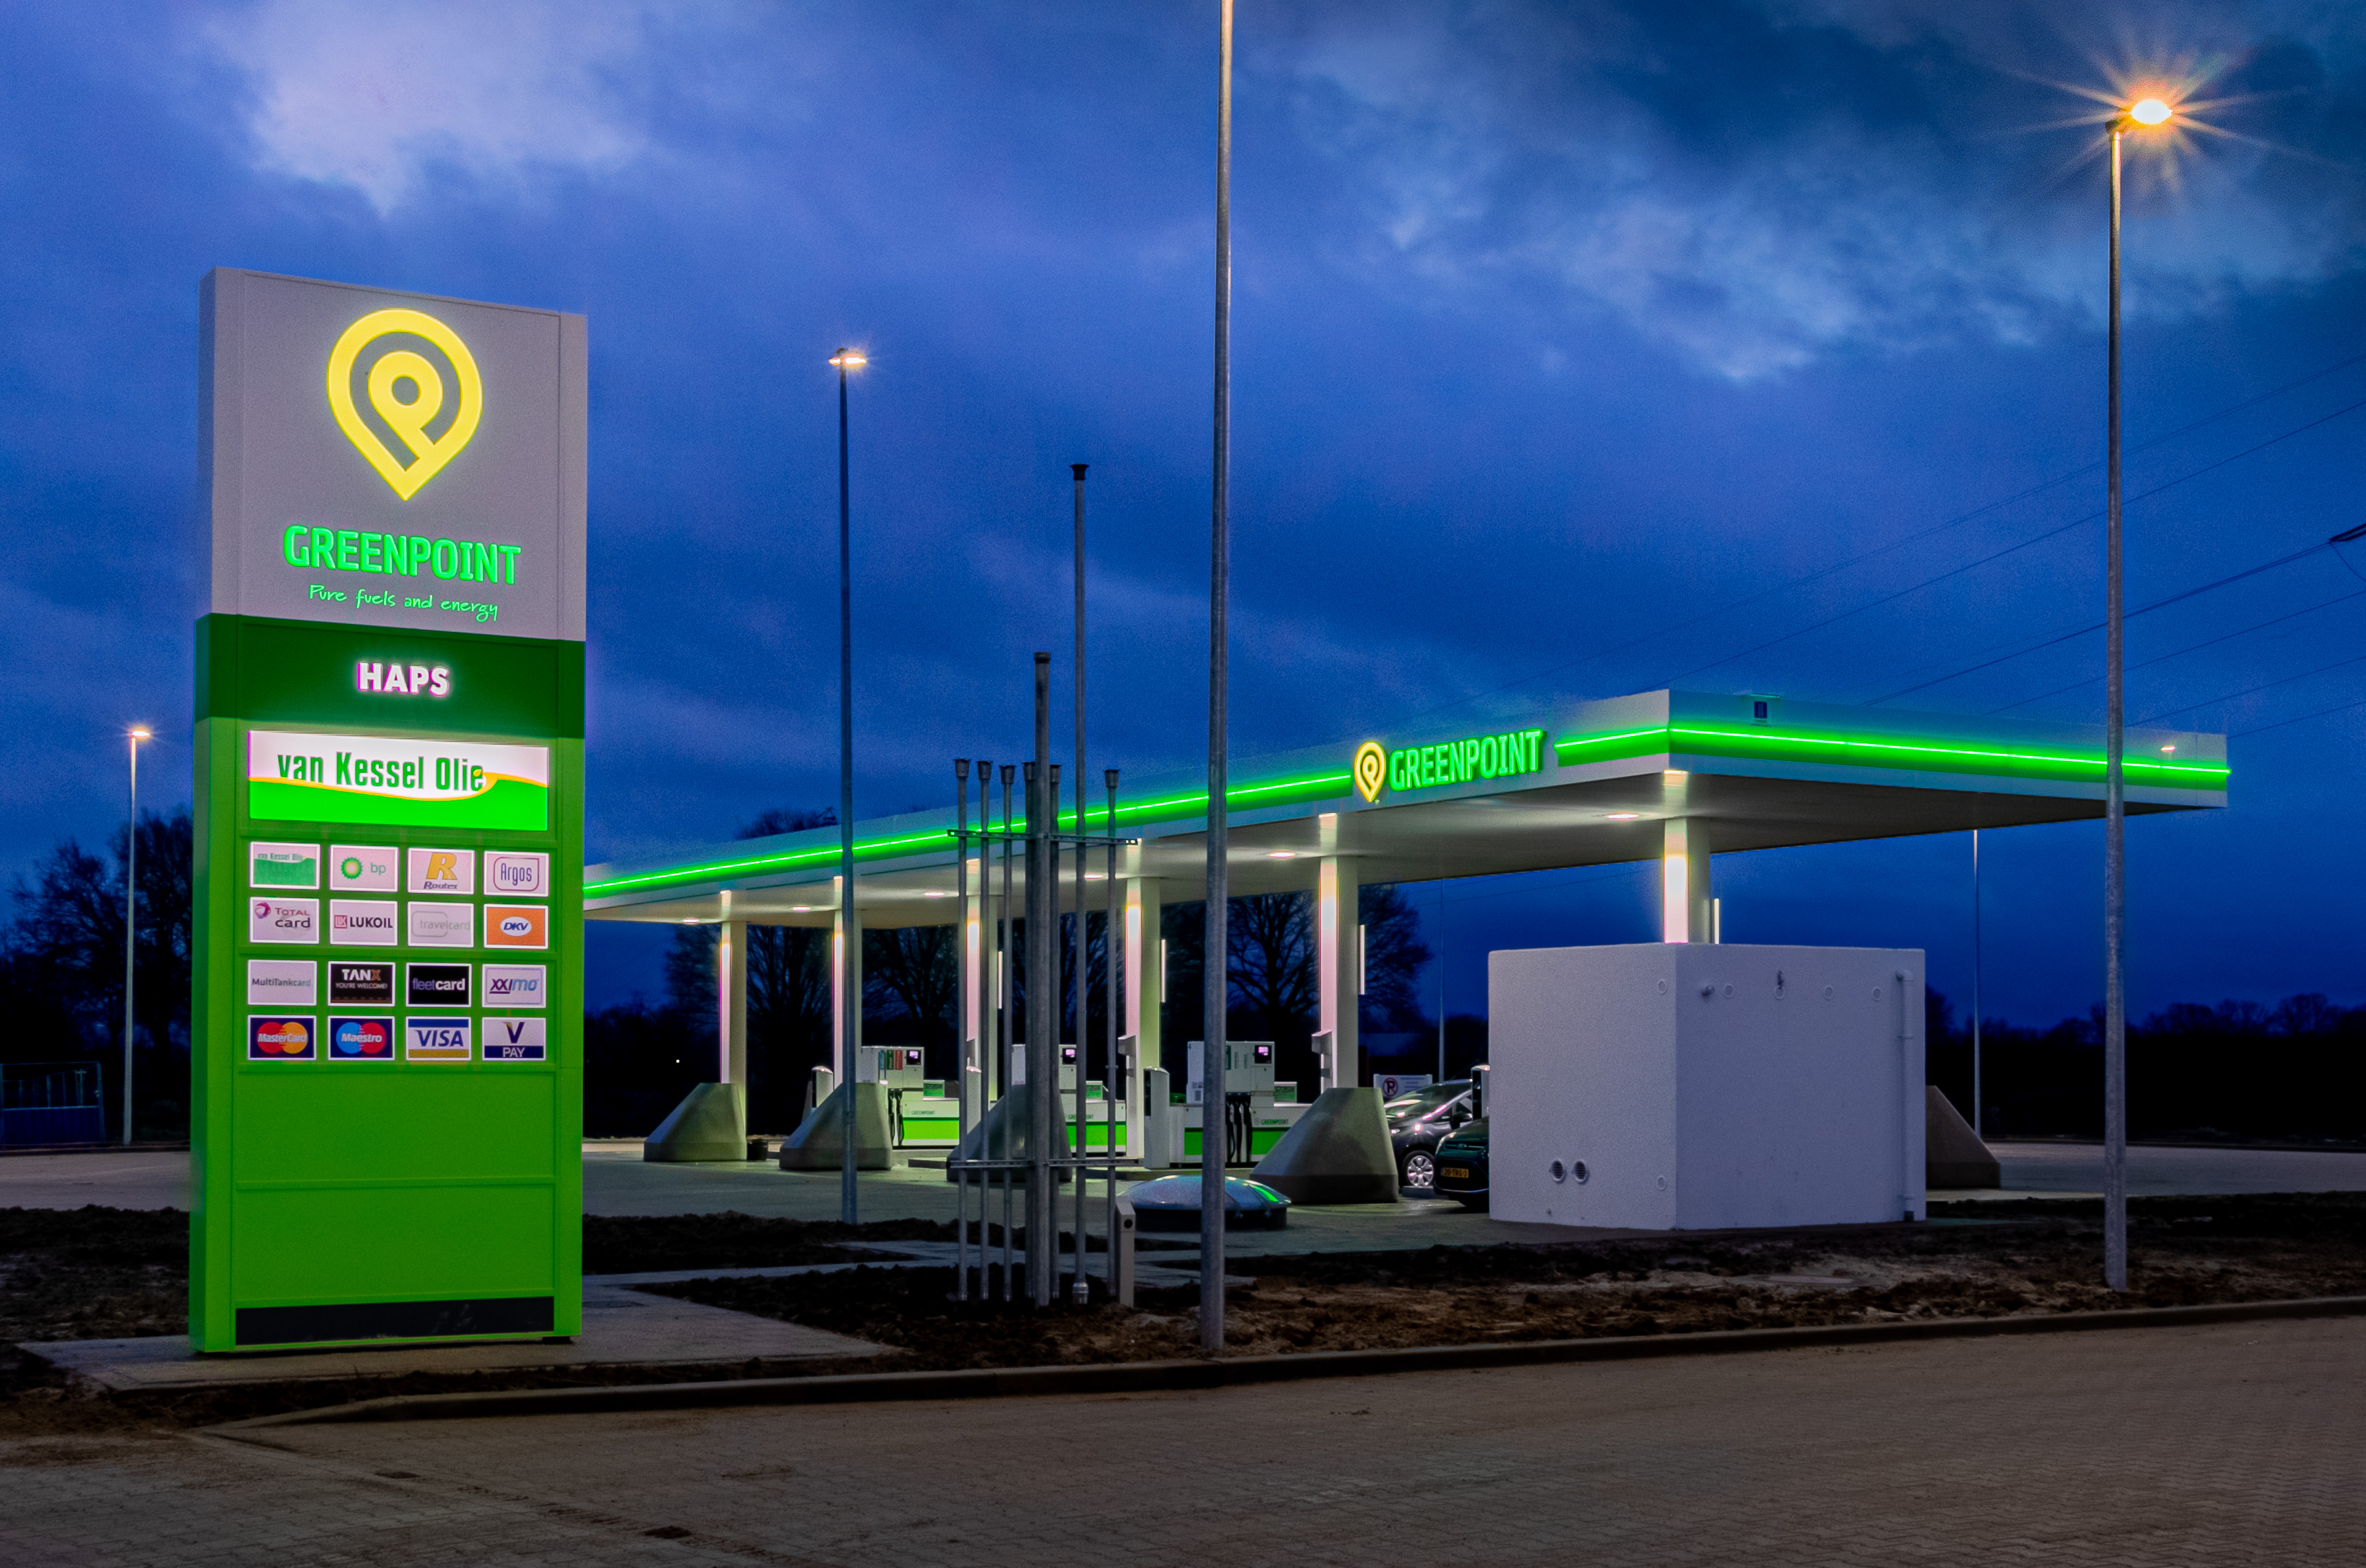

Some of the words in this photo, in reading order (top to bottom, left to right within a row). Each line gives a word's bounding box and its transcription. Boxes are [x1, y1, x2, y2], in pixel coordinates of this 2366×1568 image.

[284, 524, 521, 585] GREENPOINT
[309, 585, 347, 602] Pure
[356, 589, 395, 609] fuels
[404, 595, 433, 609] and
[440, 600, 498, 623] energy
[357, 661, 450, 697] HAPS
[1389, 727, 1544, 792] GREENPOINT
[277, 754, 324, 784] van
[336, 751, 424, 789] Kessel
[435, 757, 485, 793] Olie
[370, 862, 386, 876] bp
[500, 863, 532, 886] Argos
[423, 881, 458, 890] Routex
[275, 907, 311, 916] TOTAL
[275, 916, 311, 928] card
[349, 916, 393, 928] LUKOIL
[420, 918, 470, 931] travelcard
[503, 922, 528, 931] DKV
[342, 969, 382, 981] TANX
[412, 978, 465, 991] fleetcard
[258, 1033, 307, 1043] MasterCard
[341, 1033, 382, 1042] Maestro
[414, 1030, 464, 1047] VISA
[502, 1021, 525, 1044] V
[502, 1047, 525, 1057] PAY
